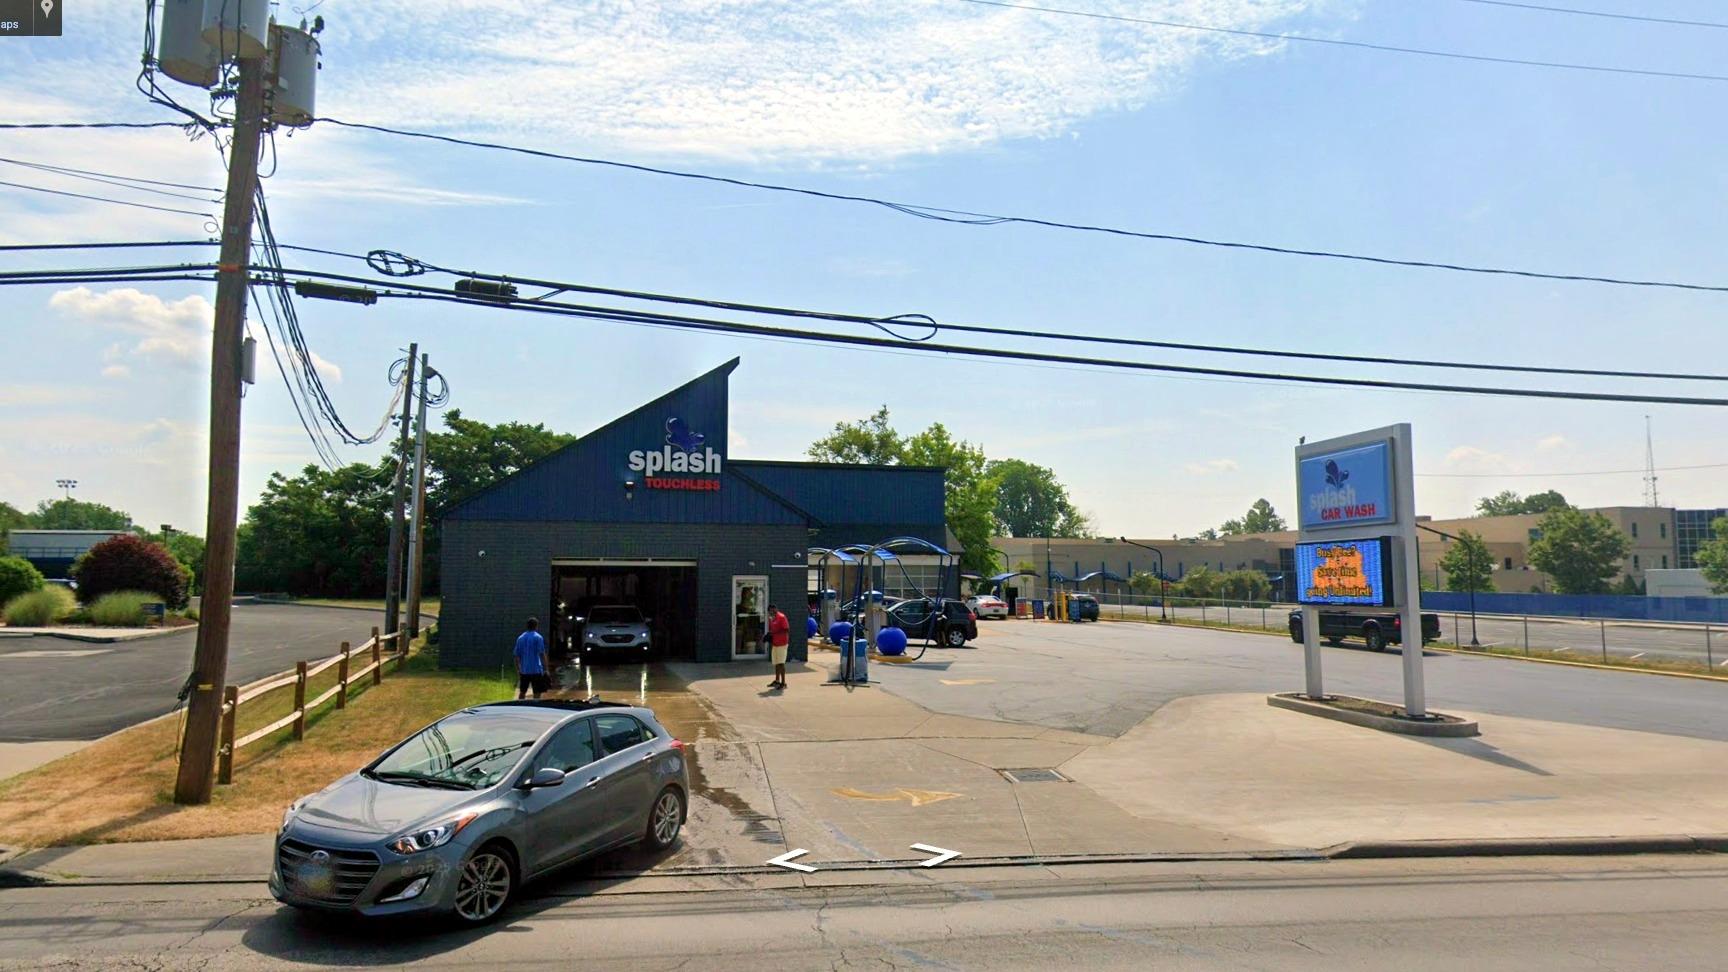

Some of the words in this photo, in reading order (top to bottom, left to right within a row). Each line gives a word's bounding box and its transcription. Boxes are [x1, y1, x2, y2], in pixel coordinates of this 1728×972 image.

[629, 446, 721, 476] splash
[645, 478, 721, 490] TOUCHLESS
[1310, 486, 1356, 513] splash
[1321, 507, 1341, 520] CAR
[1344, 503, 1376, 518] WASH
